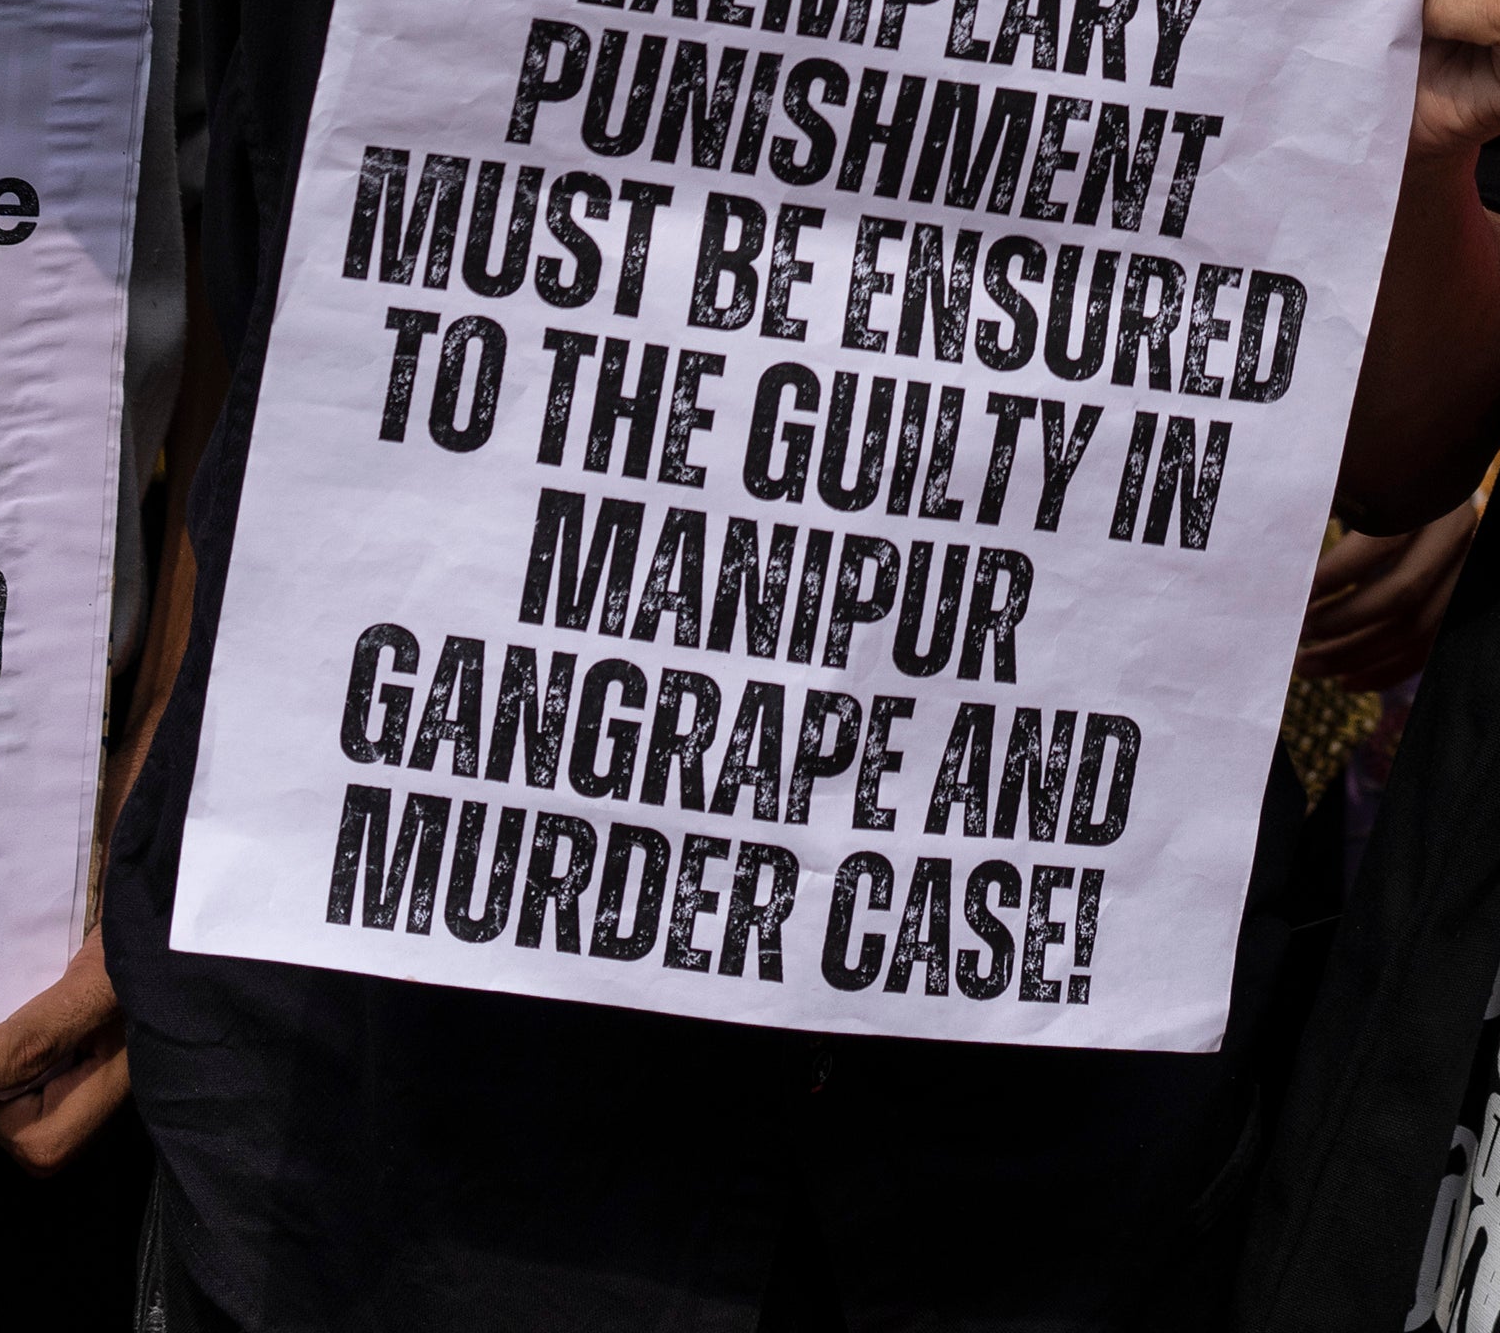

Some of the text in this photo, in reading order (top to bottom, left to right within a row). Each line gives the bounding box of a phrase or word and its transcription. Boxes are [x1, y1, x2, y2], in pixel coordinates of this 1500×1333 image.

[504, 19, 1223, 238] PUNISHMENT
[341, 145, 1308, 405] MUST BE ENSURED
[377, 305, 1234, 552] TO THE GUILTY IN
[518, 485, 1035, 686] MANIPUR
[339, 622, 1143, 846] GANGRAPE AND
[326, 783, 1106, 1006] MURDER CASE!
